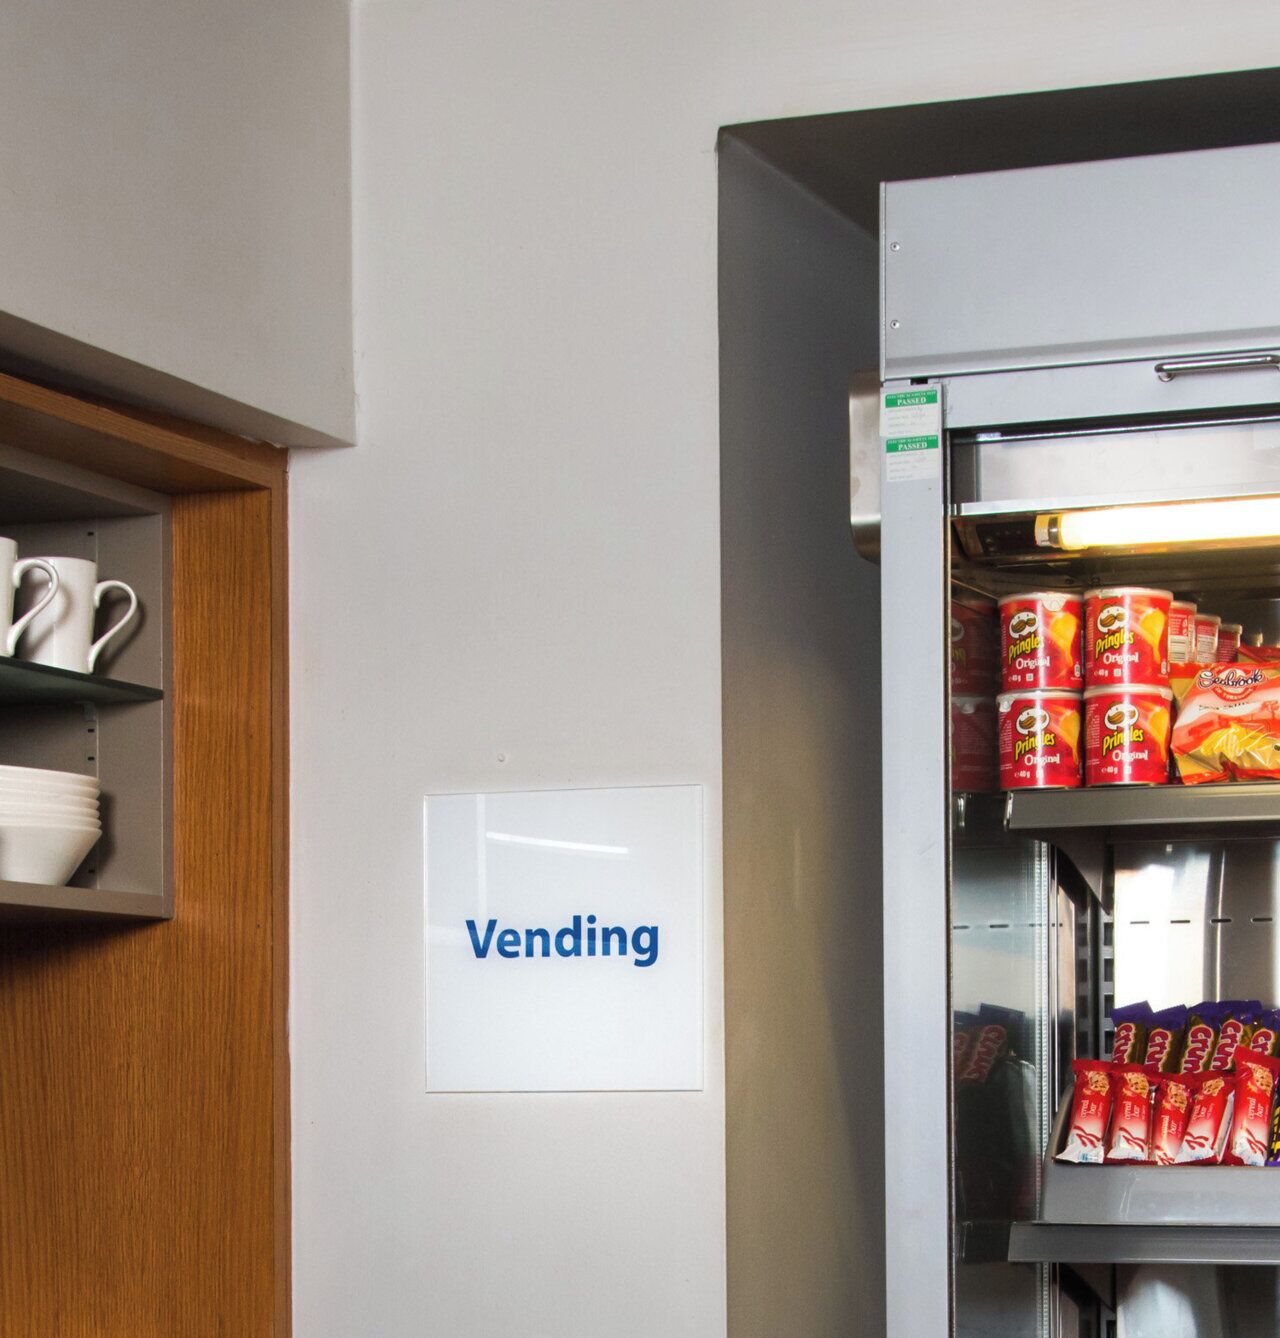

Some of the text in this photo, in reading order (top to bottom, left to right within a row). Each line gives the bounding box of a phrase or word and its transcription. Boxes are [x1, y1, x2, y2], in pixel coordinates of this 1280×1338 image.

[897, 396, 927, 406] PASSED
[898, 441, 928, 451] PASSED
[1196, 668, 1266, 690] Seabrook
[465, 914, 659, 967] Vending
